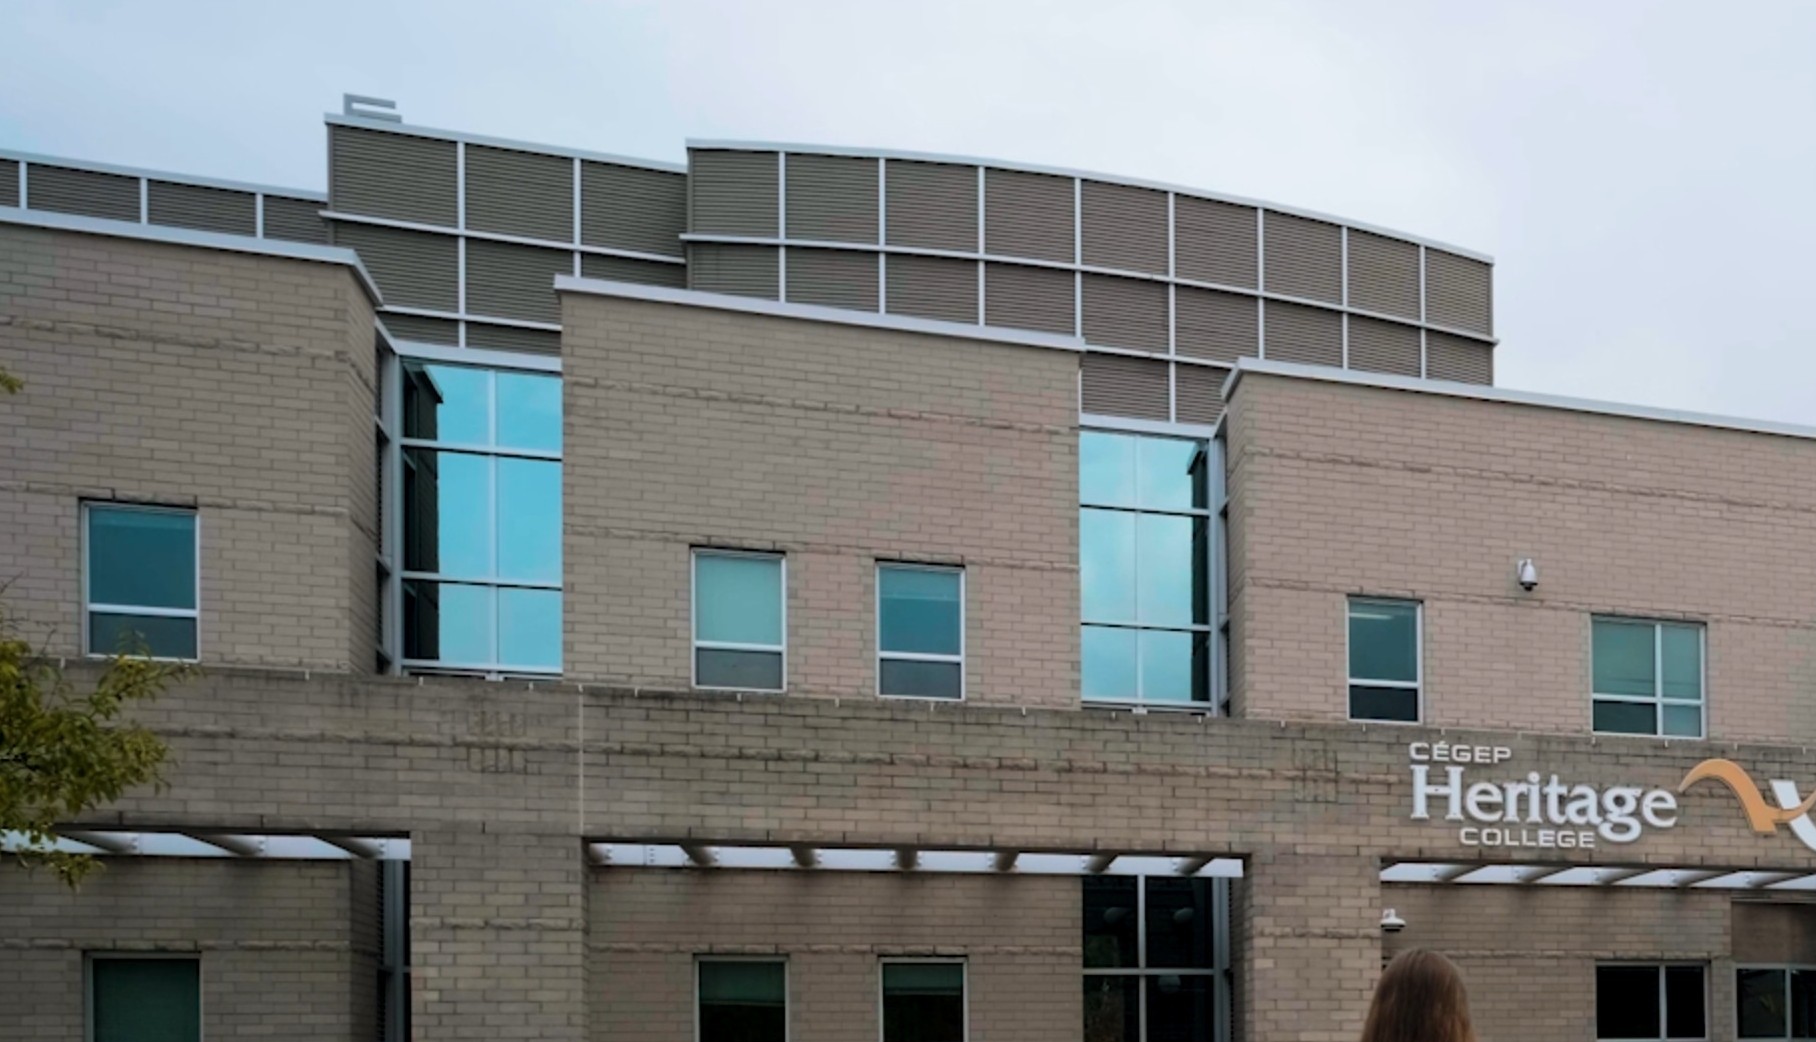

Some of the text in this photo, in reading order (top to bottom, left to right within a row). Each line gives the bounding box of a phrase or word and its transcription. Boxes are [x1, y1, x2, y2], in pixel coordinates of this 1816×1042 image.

[1409, 741, 1512, 763] CÉGEP
[1410, 764, 1678, 842] Heritage
[1460, 827, 1595, 847] COLLEGE
